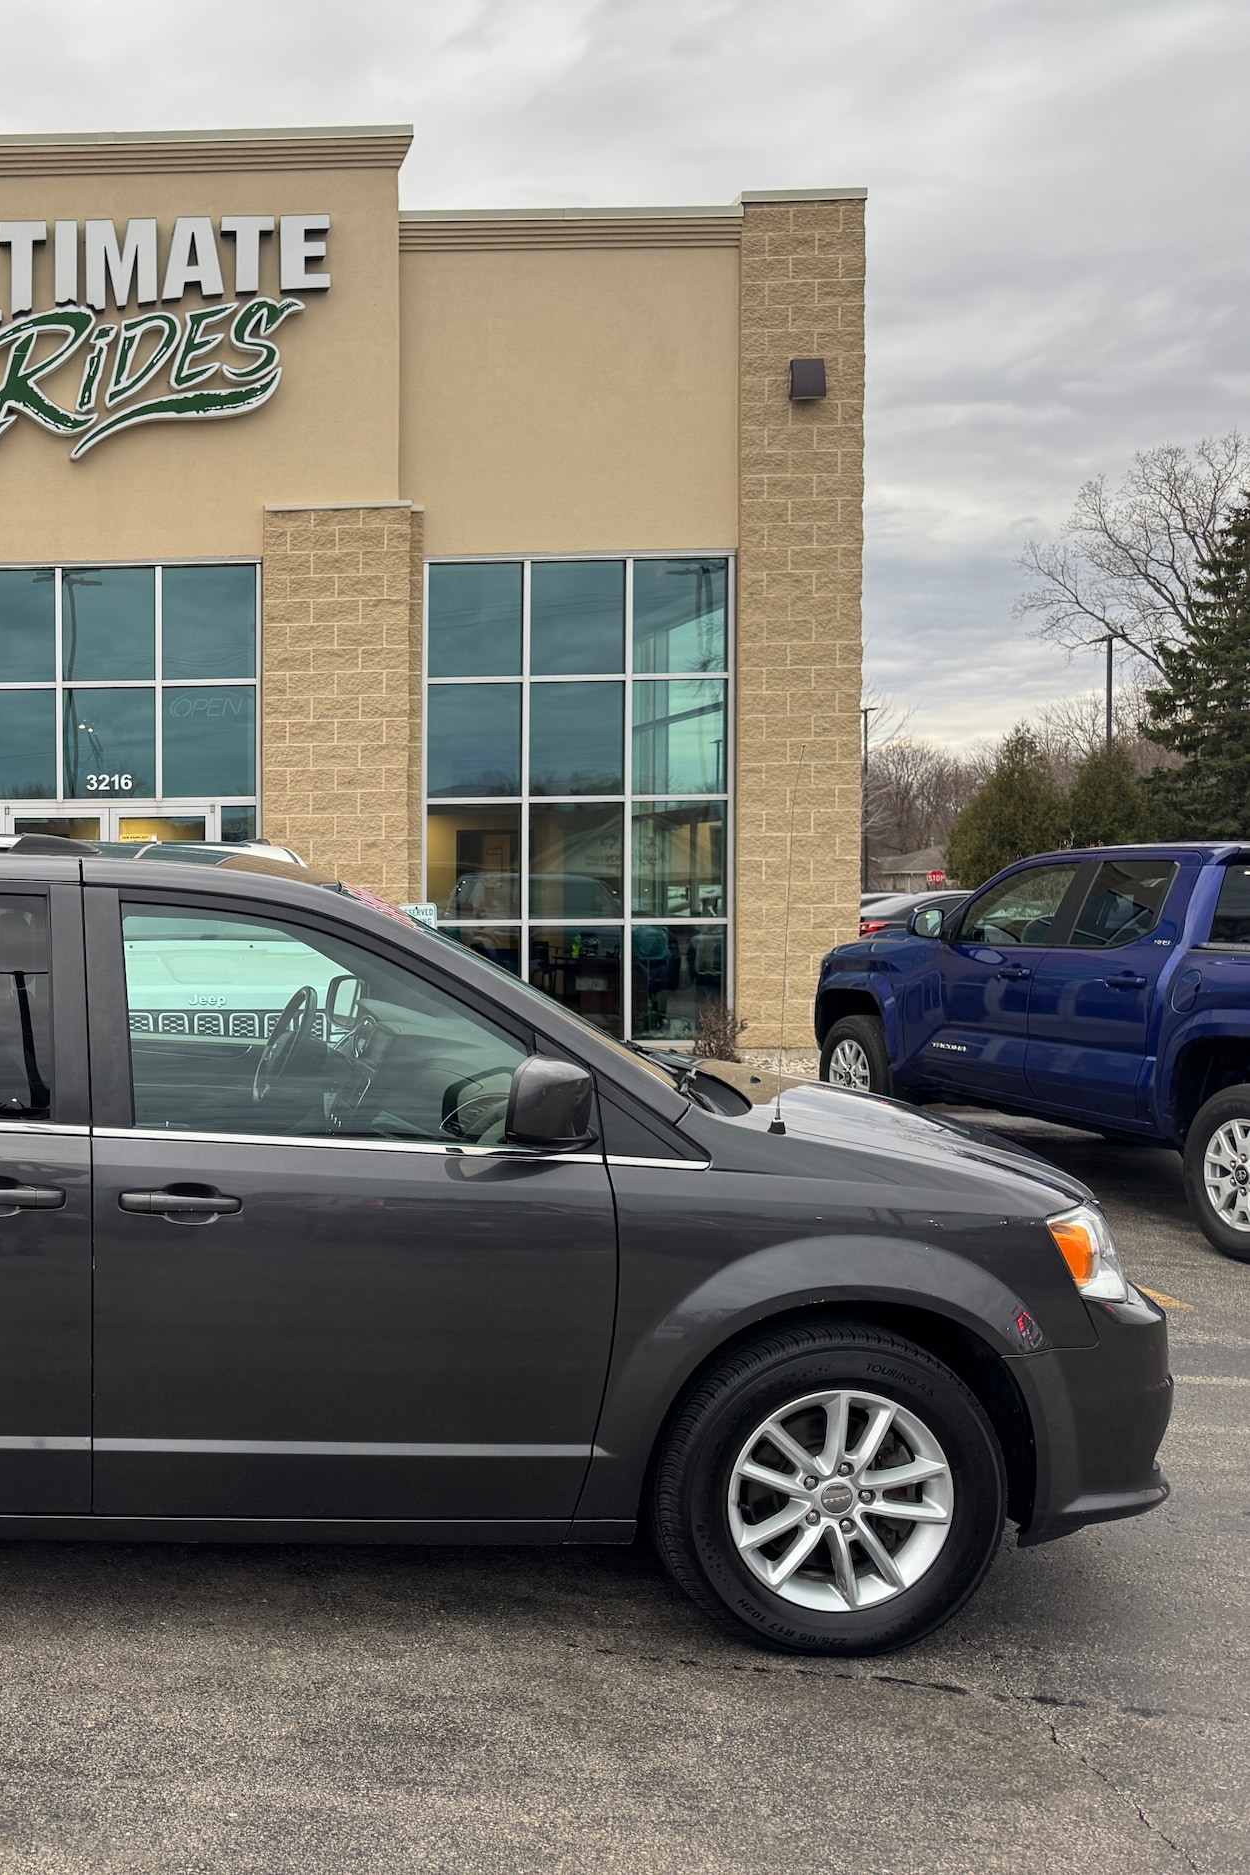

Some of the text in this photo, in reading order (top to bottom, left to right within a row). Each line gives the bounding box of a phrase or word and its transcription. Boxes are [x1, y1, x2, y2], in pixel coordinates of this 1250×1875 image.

[173, 697, 244, 718] OPEN
[86, 773, 133, 791] 3216
[927, 874, 946, 882] STOP
[188, 993, 227, 1008] Jeep
[865, 1362, 917, 1387] TOURING
[736, 1596, 847, 1646] 225/65 R17 102H
